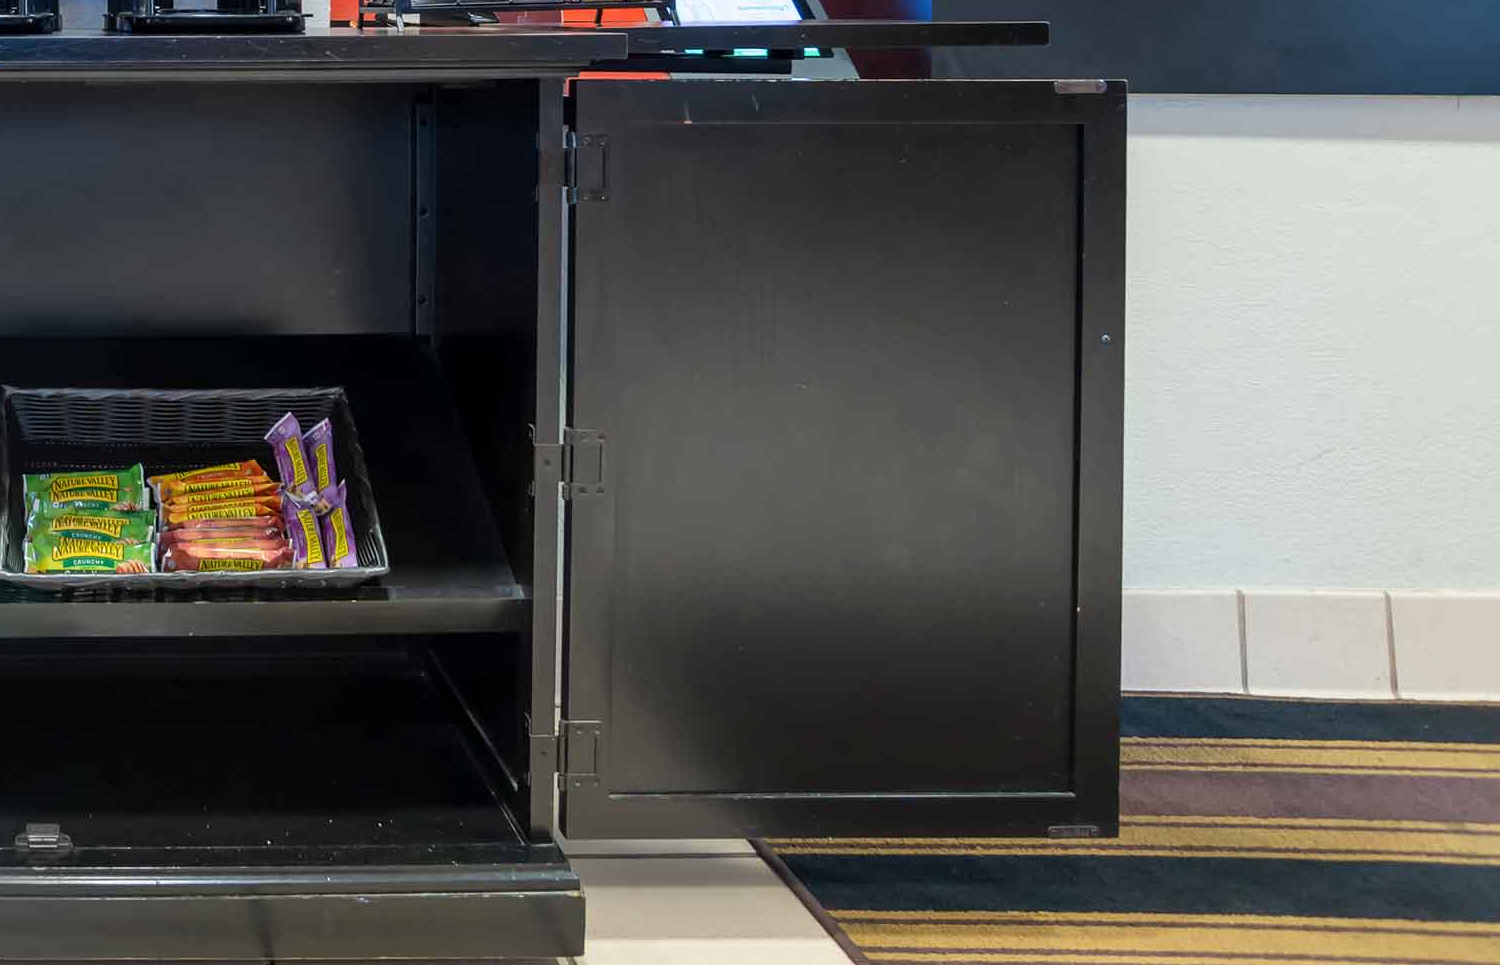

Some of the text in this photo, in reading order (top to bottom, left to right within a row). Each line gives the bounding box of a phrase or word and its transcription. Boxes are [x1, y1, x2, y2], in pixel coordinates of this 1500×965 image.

[54, 476, 116, 492] NATURE VALLEY
[86, 490, 115, 501] VALLEY
[54, 544, 122, 559] NATURE VALLEY
[232, 559, 261, 570] VALLEY
